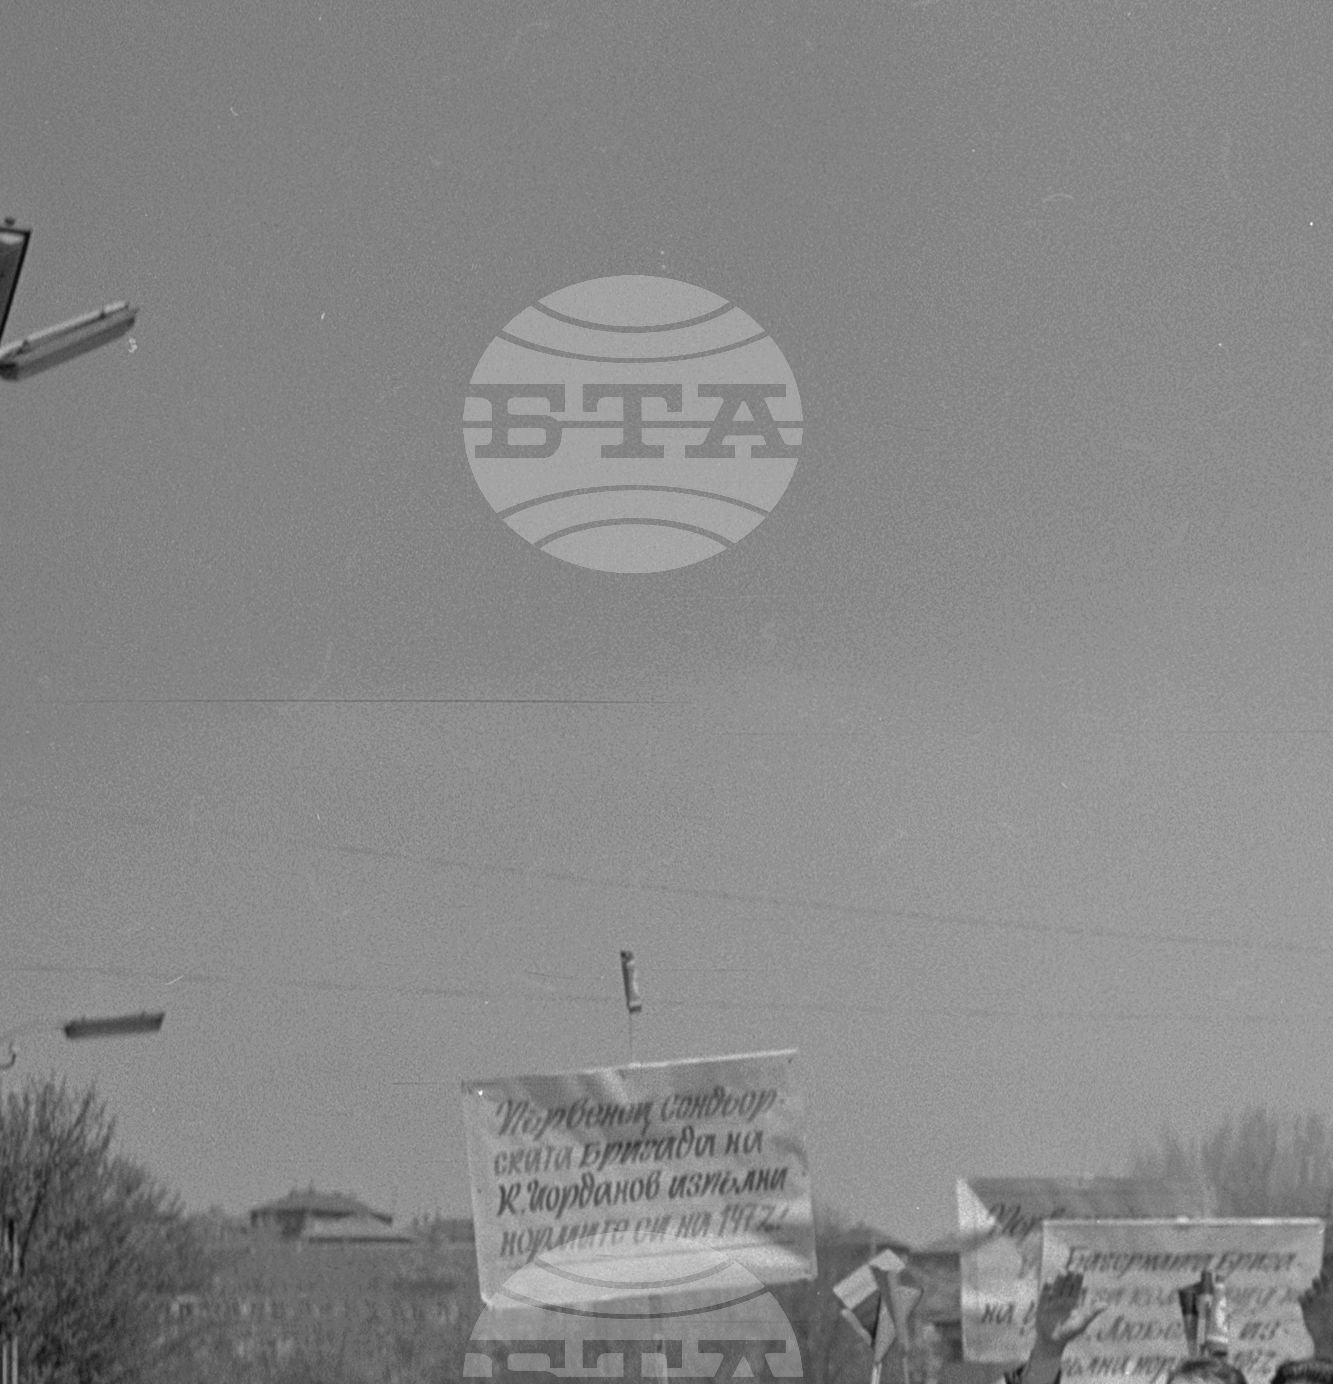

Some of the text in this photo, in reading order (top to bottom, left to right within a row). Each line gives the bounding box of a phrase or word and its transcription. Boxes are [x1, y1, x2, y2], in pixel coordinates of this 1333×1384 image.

[493, 1124, 765, 1176] ската Бригада на
[667, 1166, 789, 1200] изпълни
[499, 1217, 631, 1264] нормите
[632, 1213, 673, 1245] си
[674, 1210, 713, 1240] на
